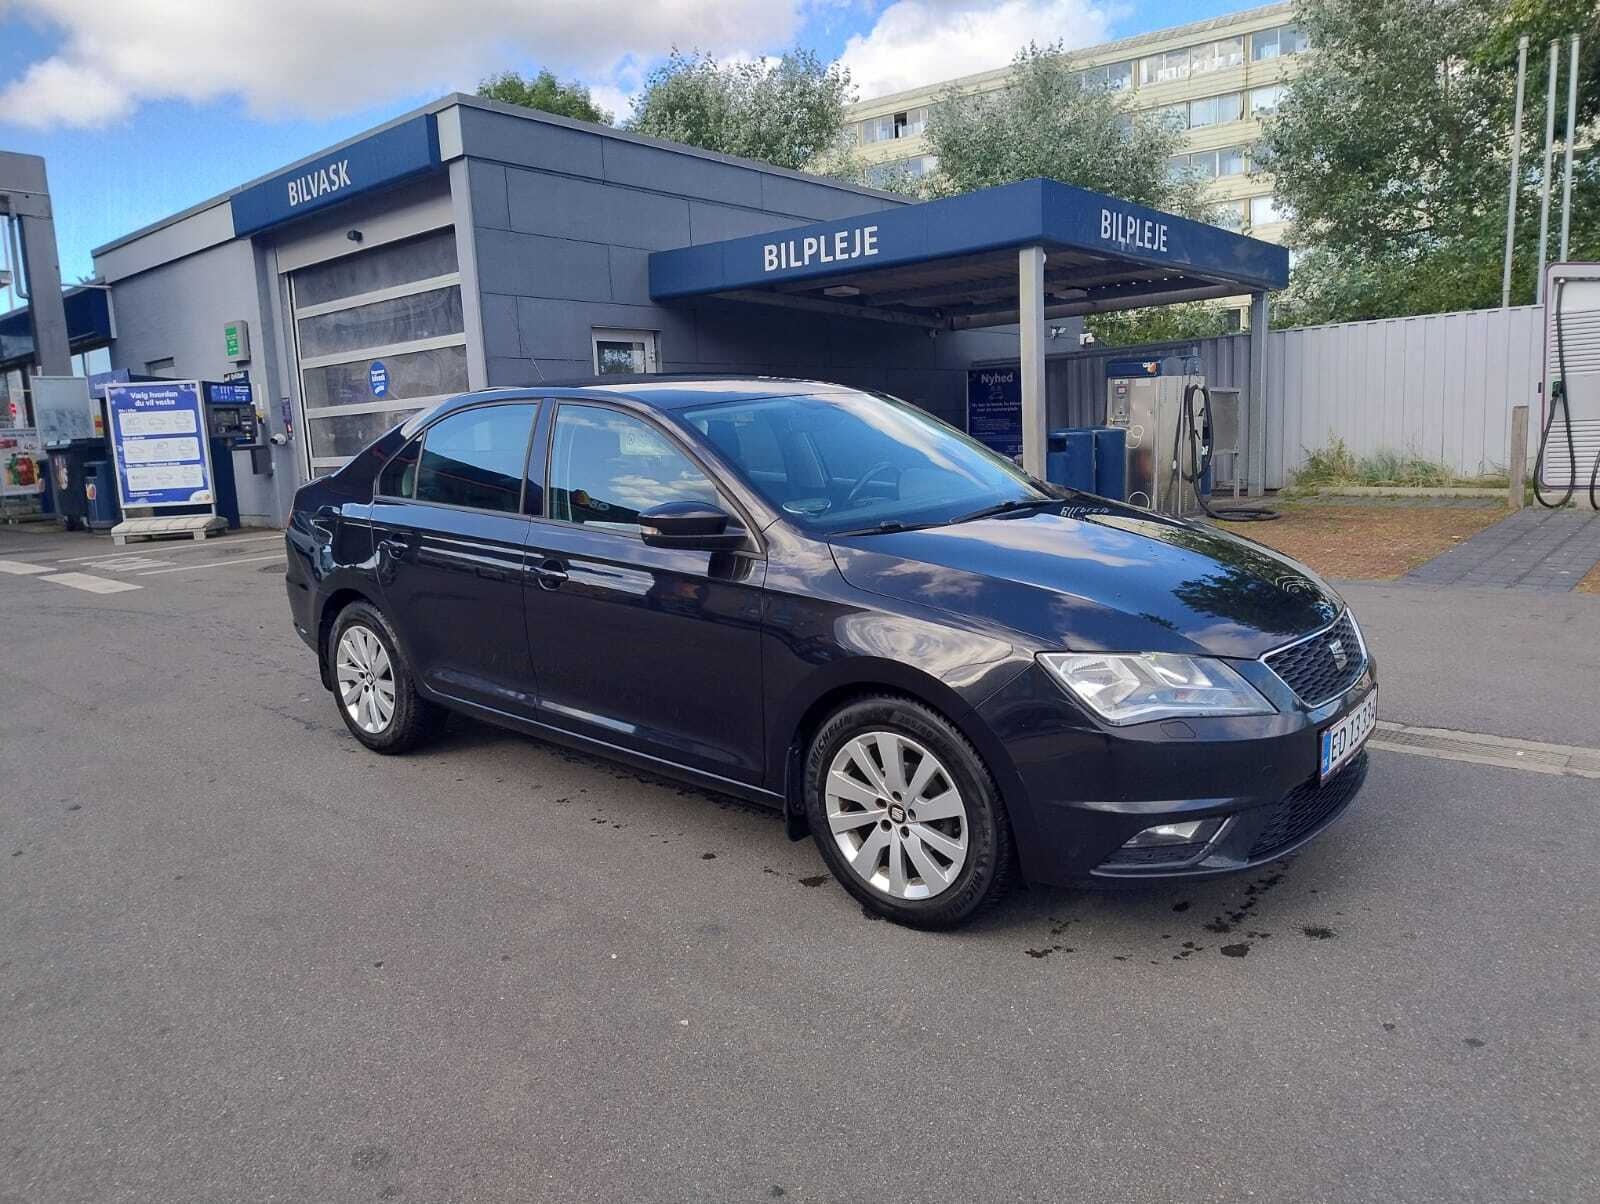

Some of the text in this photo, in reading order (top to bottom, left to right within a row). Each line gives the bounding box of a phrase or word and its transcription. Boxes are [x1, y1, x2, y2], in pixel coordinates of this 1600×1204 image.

[287, 159, 352, 207] BILVASK
[763, 225, 879, 272] BILPLEJE
[1100, 208, 1168, 253] BILPLEJE
[981, 371, 1014, 386] Nyhed
[1332, 728, 1347, 762] ED
